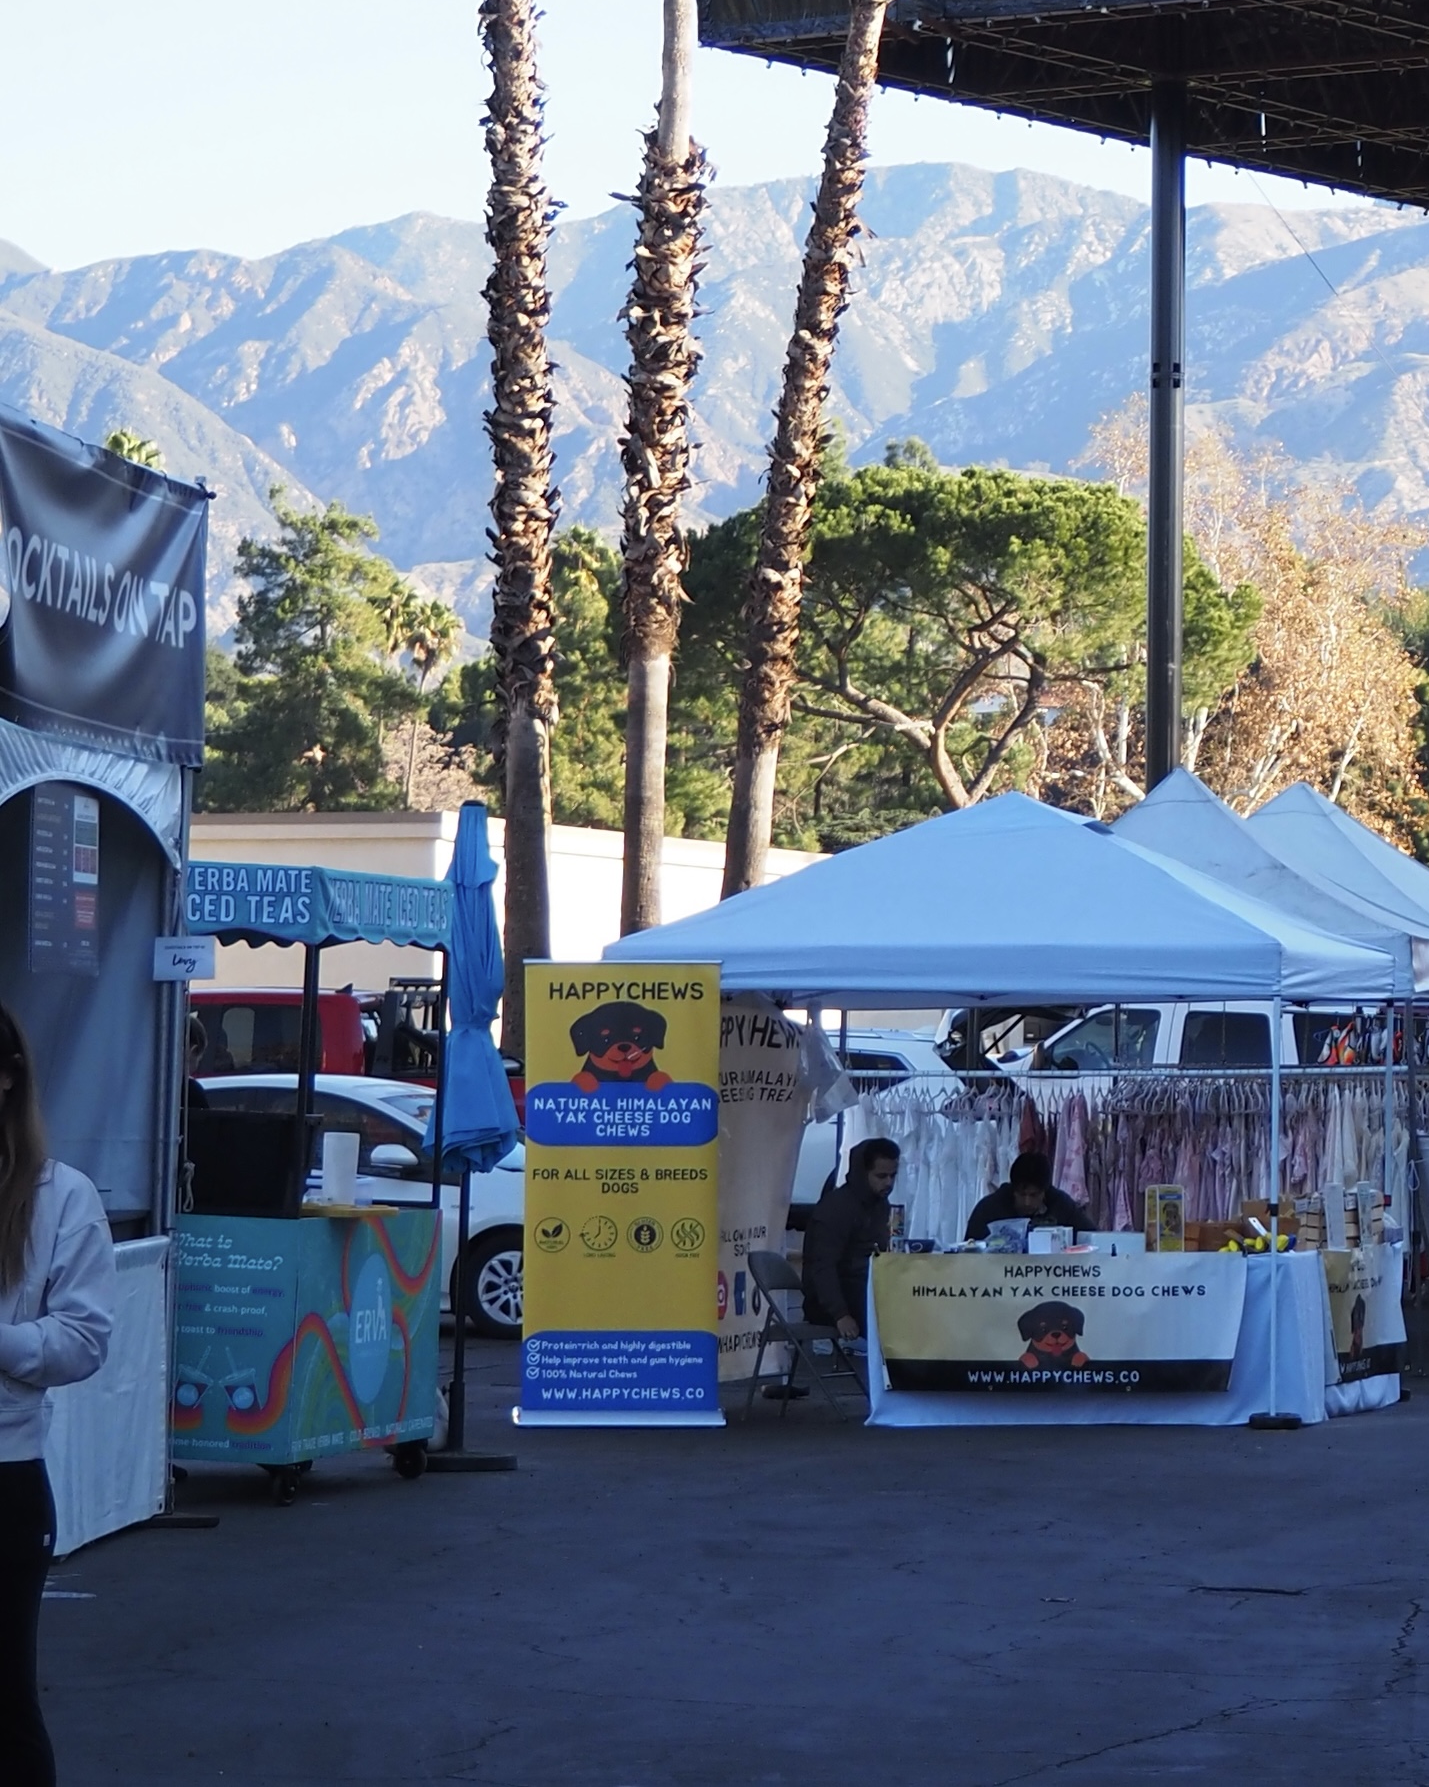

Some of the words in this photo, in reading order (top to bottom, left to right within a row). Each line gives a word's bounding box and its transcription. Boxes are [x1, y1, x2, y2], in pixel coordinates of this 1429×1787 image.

[113, 570, 148, 637] ON
[150, 580, 197, 649] TAP
[256, 869, 312, 894] MATE
[247, 895, 312, 924] TEAS
[364, 881, 393, 927] MATE
[395, 883, 420, 928] ICED
[422, 886, 449, 930] TEAS
[550, 982, 704, 1000] HAPPYCHEWS
[534, 1098, 611, 1110] NATURAL
[617, 1098, 712, 1110] HIMALAYAN
[555, 1112, 587, 1123] YAK
[593, 1112, 653, 1123] CHEESE
[660, 1112, 691, 1123] DOG
[596, 1125, 650, 1136] CHEWS
[533, 1169, 559, 1180] FOR
[564, 1169, 590, 1180] ALL
[595, 1169, 635, 1180] SIZES
[640, 1169, 650, 1180] &
[655, 1169, 708, 1180] BREEDS
[601, 1182, 639, 1194] DOGS
[1004, 1265, 1101, 1277] HAPPYCHEWS
[214, 1284, 239, 1293] boost
[241, 1285, 251, 1294] of
[912, 1286, 1003, 1298] HIMALAYAN
[1010, 1286, 1043, 1297] YAK
[1051, 1286, 1106, 1297] CHEESE
[1111, 1286, 1145, 1297] DOG
[1151, 1285, 1206, 1296] CHEWS
[204, 1303, 211, 1312] &
[181, 1325, 204, 1334] toast
[206, 1325, 216, 1334] to
[355, 1309, 387, 1343] ERVA
[541, 1341, 600, 1350] Protein-rich
[602, 1341, 618, 1350] and
[620, 1340, 646, 1352] highly
[648, 1340, 692, 1352] digestible
[541, 1355, 561, 1366] Help
[563, 1356, 599, 1366] improve
[602, 1355, 629, 1365] teeth
[631, 1355, 647, 1365] and
[650, 1357, 667, 1366] gum
[669, 1355, 703, 1366] hygiene
[541, 1370, 567, 1379] 100%
[569, 1370, 606, 1379] Natural
[609, 1370, 637, 1379] Chews
[968, 1370, 1140, 1384] WWW.HAPPYCHEWS.CO
[542, 1388, 704, 1400] WWW.HAPPYCHEWS.CO
